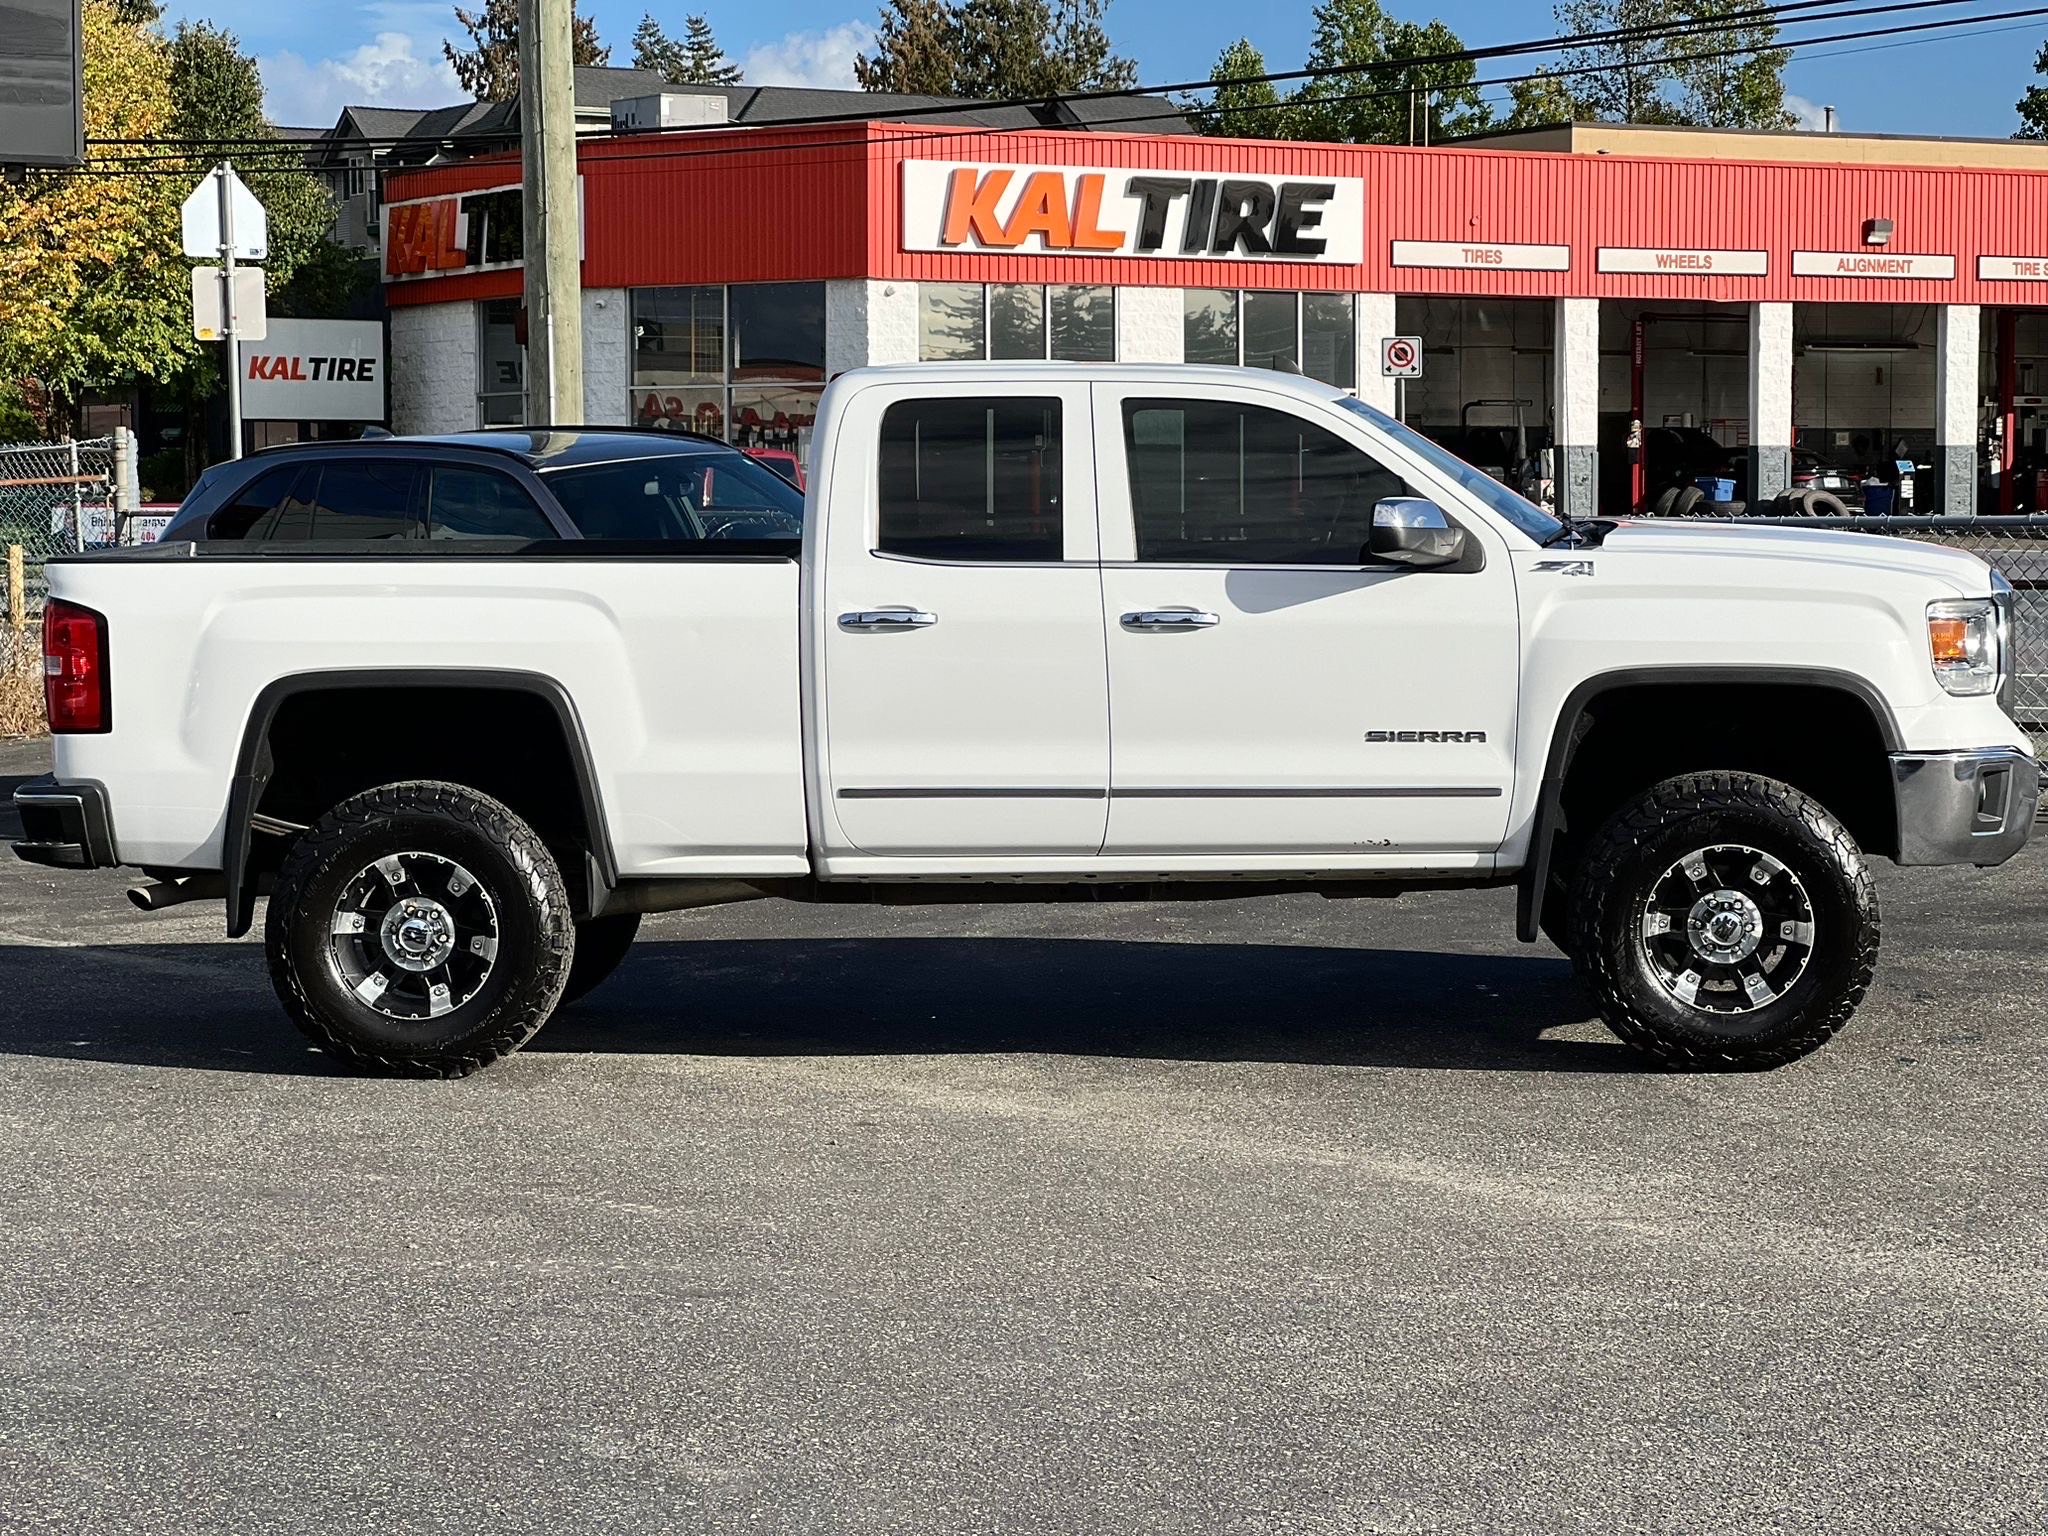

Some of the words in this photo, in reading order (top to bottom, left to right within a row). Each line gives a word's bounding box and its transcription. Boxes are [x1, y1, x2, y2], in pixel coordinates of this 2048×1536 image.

[1462, 249, 1503, 264] TIRES
[1656, 254, 1712, 270] WHEELS
[1837, 258, 1913, 274] ALIGNMENT
[2012, 262, 2041, 276] TIRE
[1364, 731, 1487, 743] SIERRA
